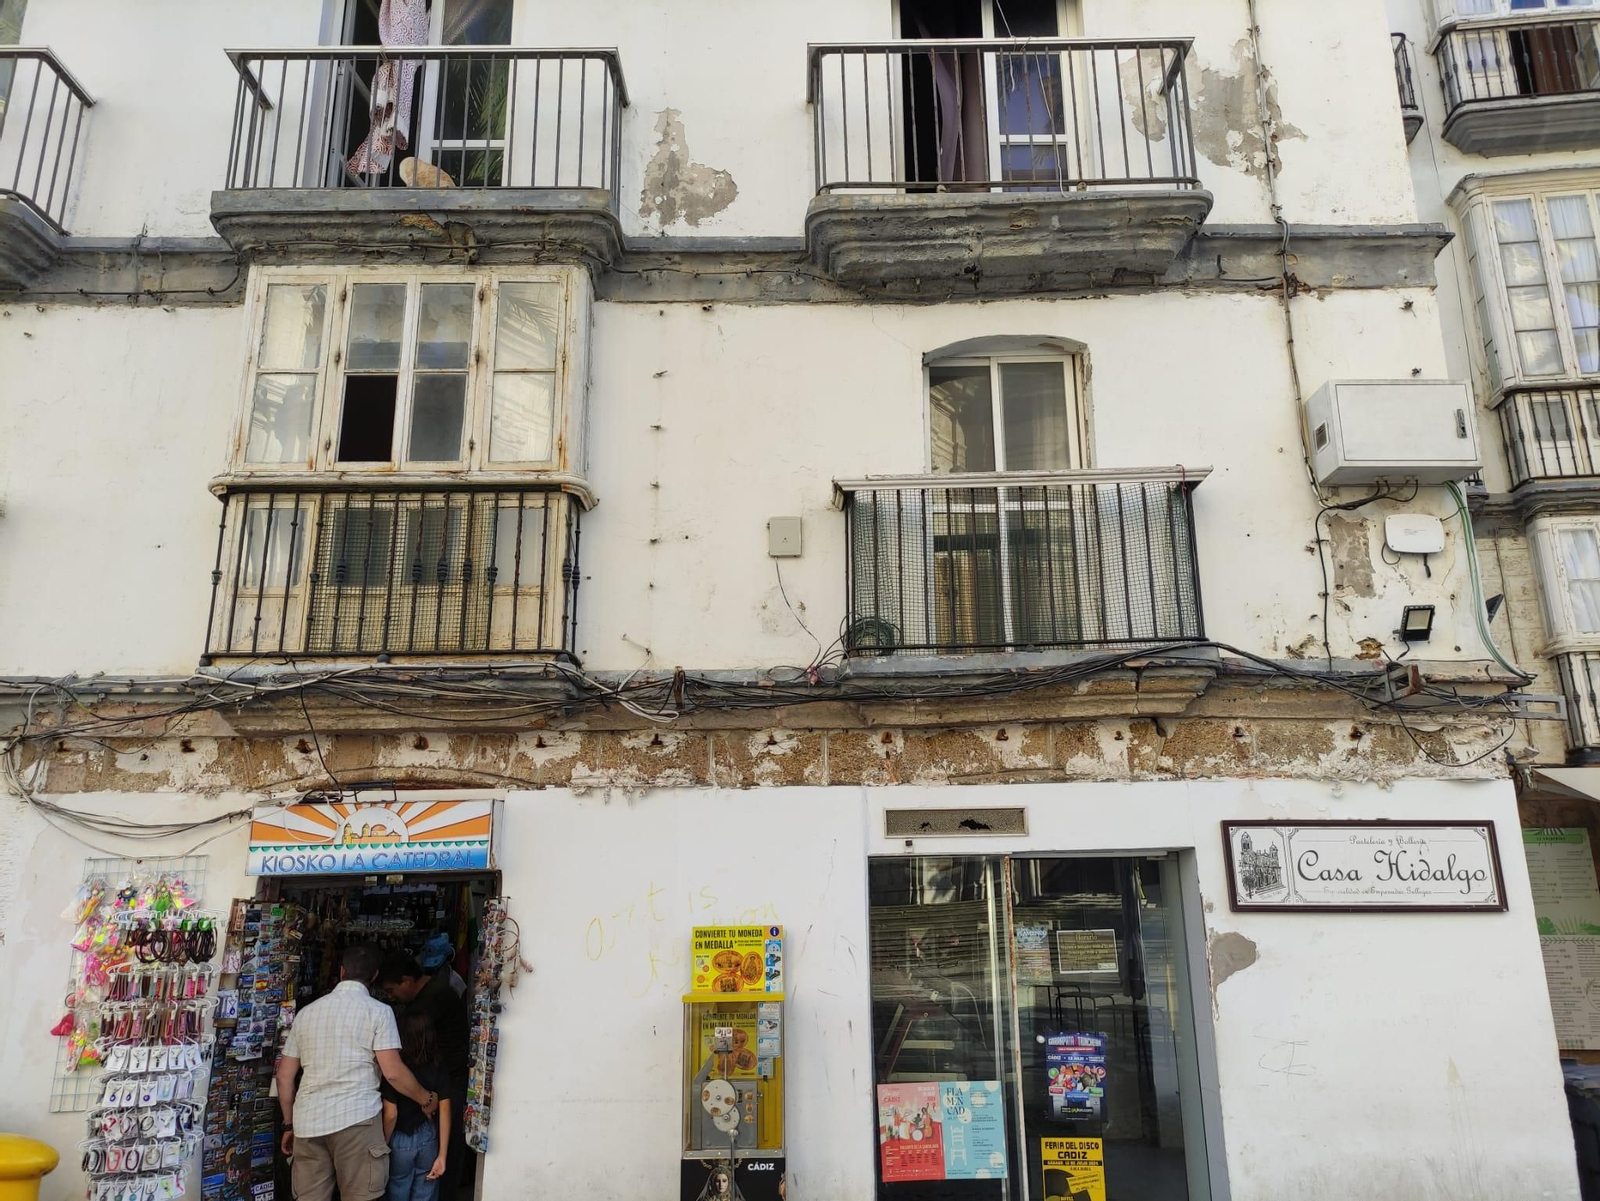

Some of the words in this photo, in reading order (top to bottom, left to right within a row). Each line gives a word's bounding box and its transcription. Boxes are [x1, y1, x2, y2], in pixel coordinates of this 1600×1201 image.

[261, 854, 336, 873] KIOSKO
[342, 853, 369, 871] LA
[372, 850, 476, 869] CATEDRAL
[1297, 849, 1363, 882] Casa
[1374, 849, 1488, 895] Hidalgo
[1323, 886, 1361, 896] Espcialidad
[695, 929, 727, 939] CONVIERTE
[728, 929, 736, 938] TU
[737, 929, 763, 938] MONEDA
[695, 941, 703, 950] EN
[704, 940, 734, 950] MEDALLA
[946, 1087, 964, 1096] FLA
[946, 1097, 965, 1106] MEN
[946, 1107, 966, 1116] CAD
[1045, 1141, 1065, 1150] FERIA
[1065, 1141, 1078, 1150] DEL
[1079, 1141, 1099, 1150] DISCO
[1058, 1151, 1088, 1160] CADIZ
[747, 1161, 775, 1171] CÁDIZ
